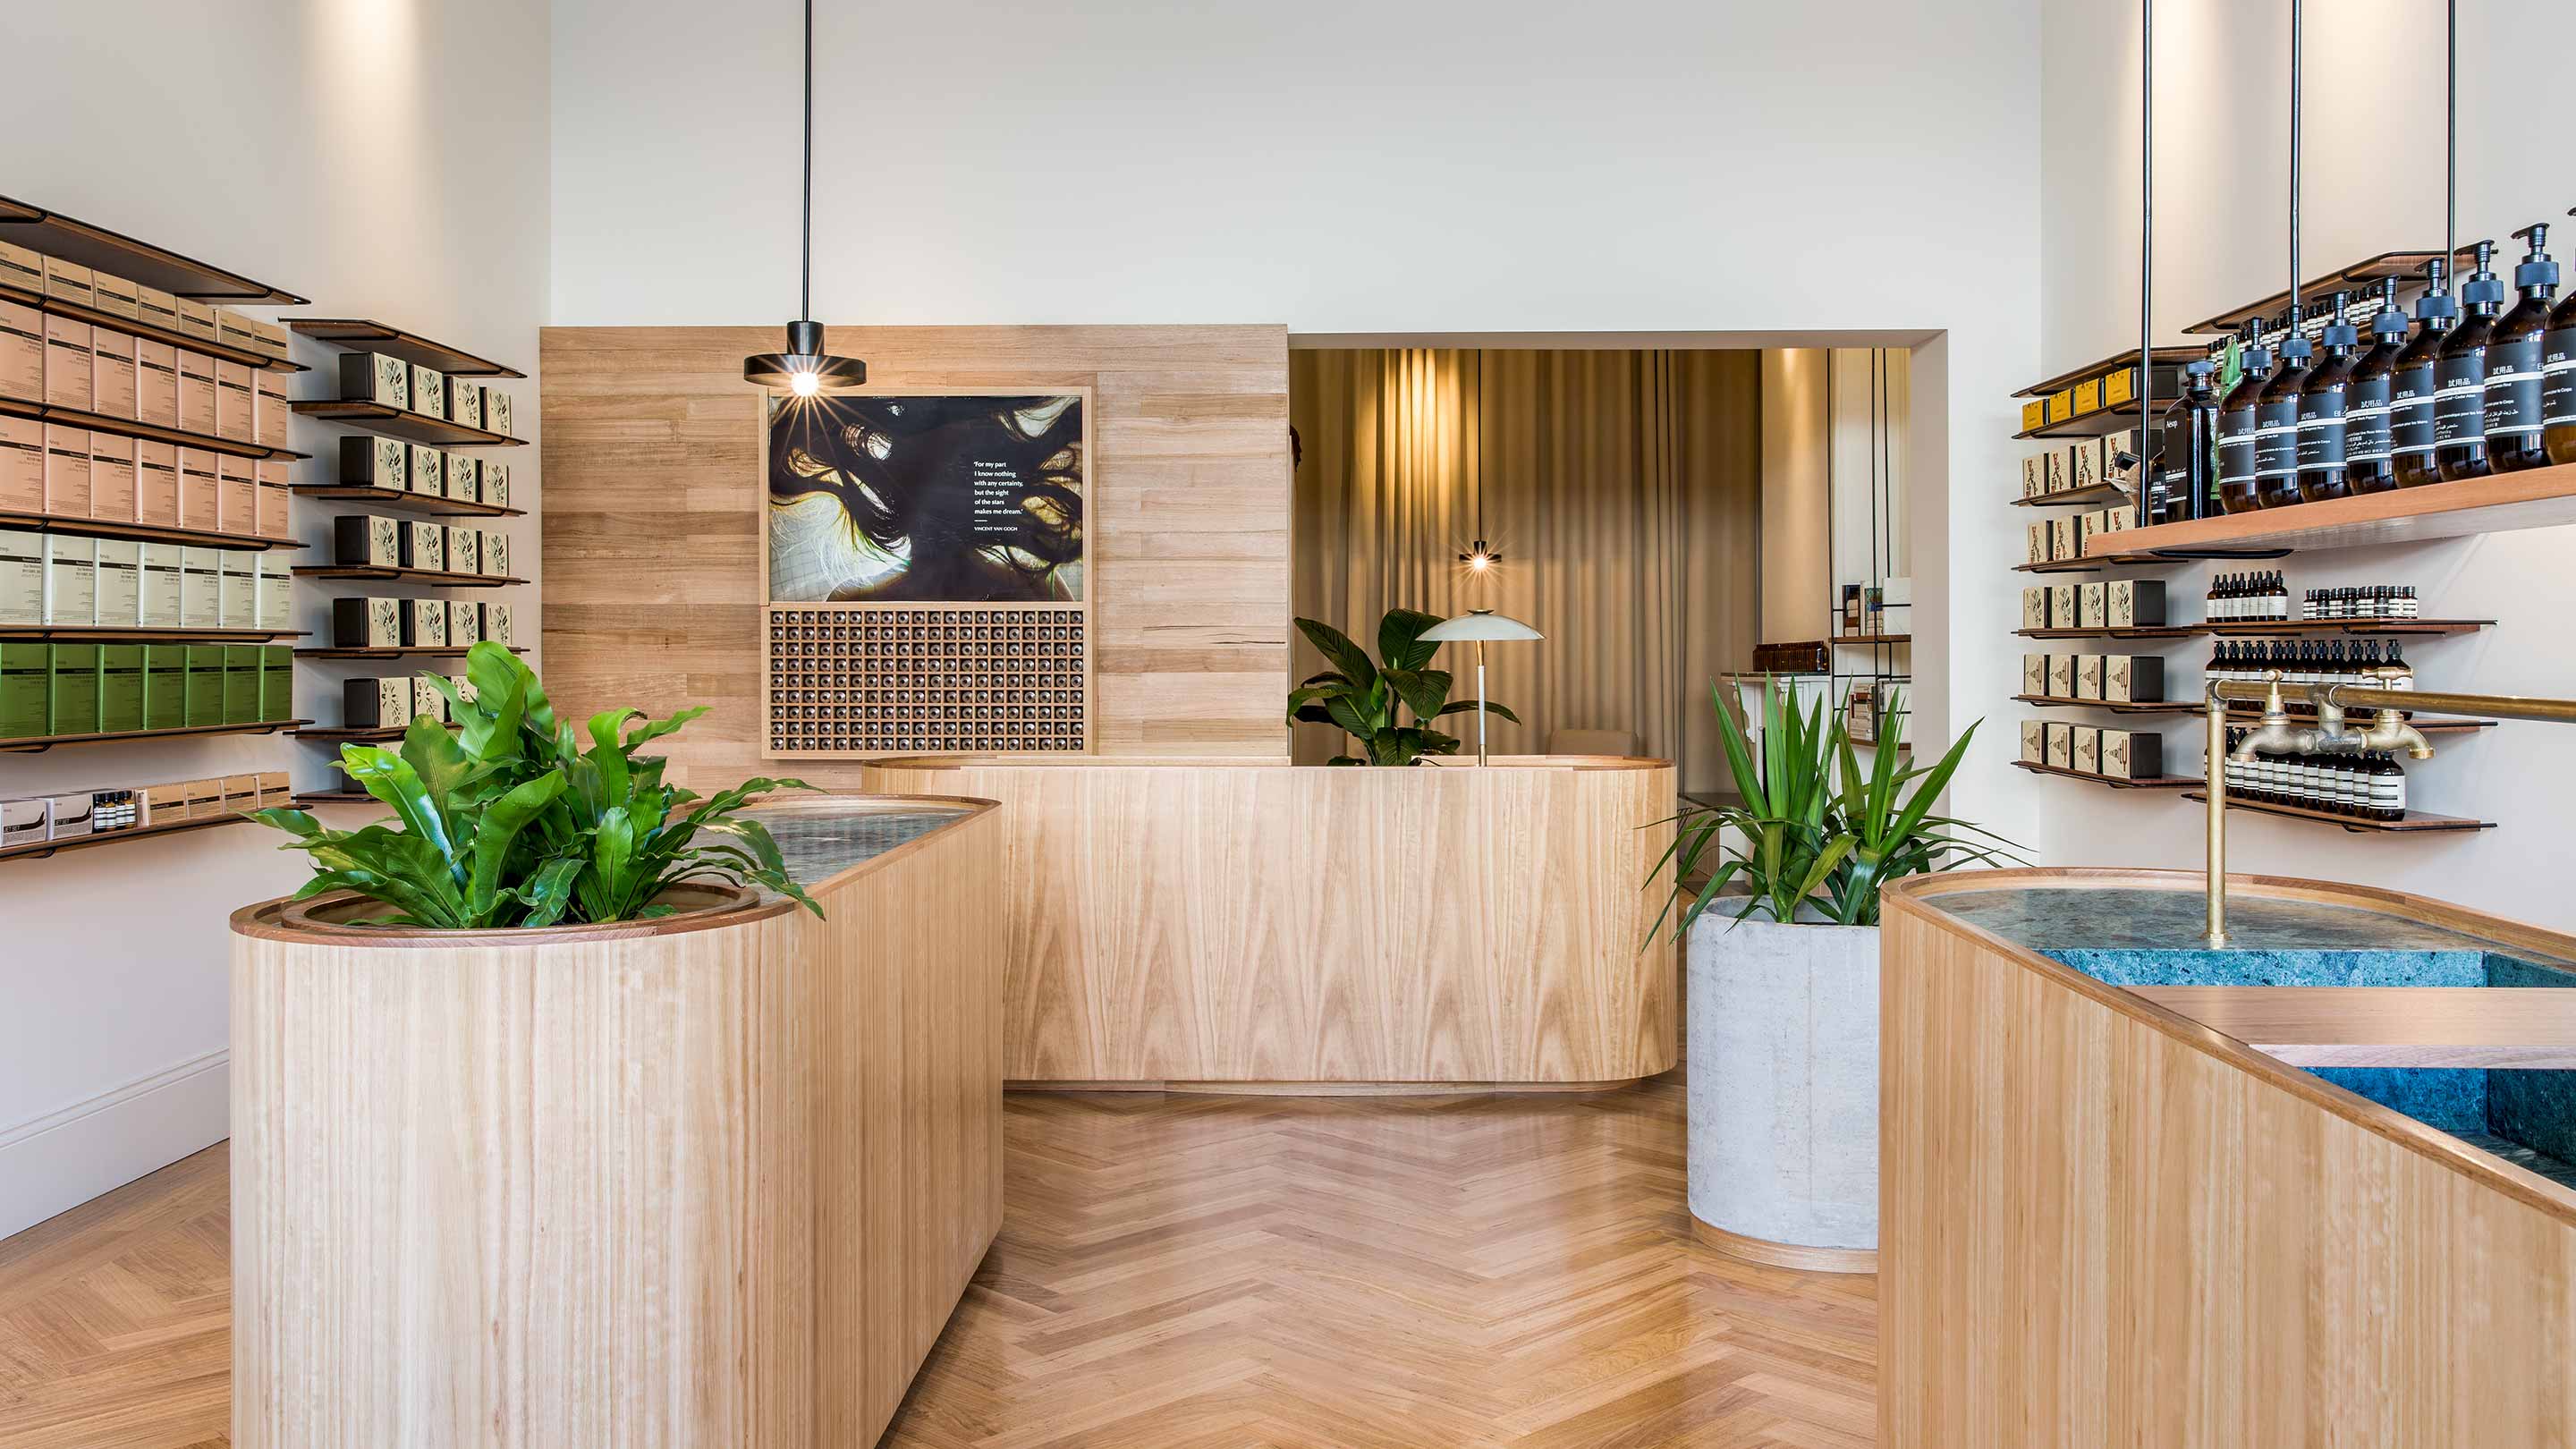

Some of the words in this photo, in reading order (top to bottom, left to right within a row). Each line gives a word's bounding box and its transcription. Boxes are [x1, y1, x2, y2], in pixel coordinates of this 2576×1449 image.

[2493, 365, 2513, 374] 試用品
[2448, 378, 2470, 386] 試用品
[2166, 420, 2178, 428] Aesop
